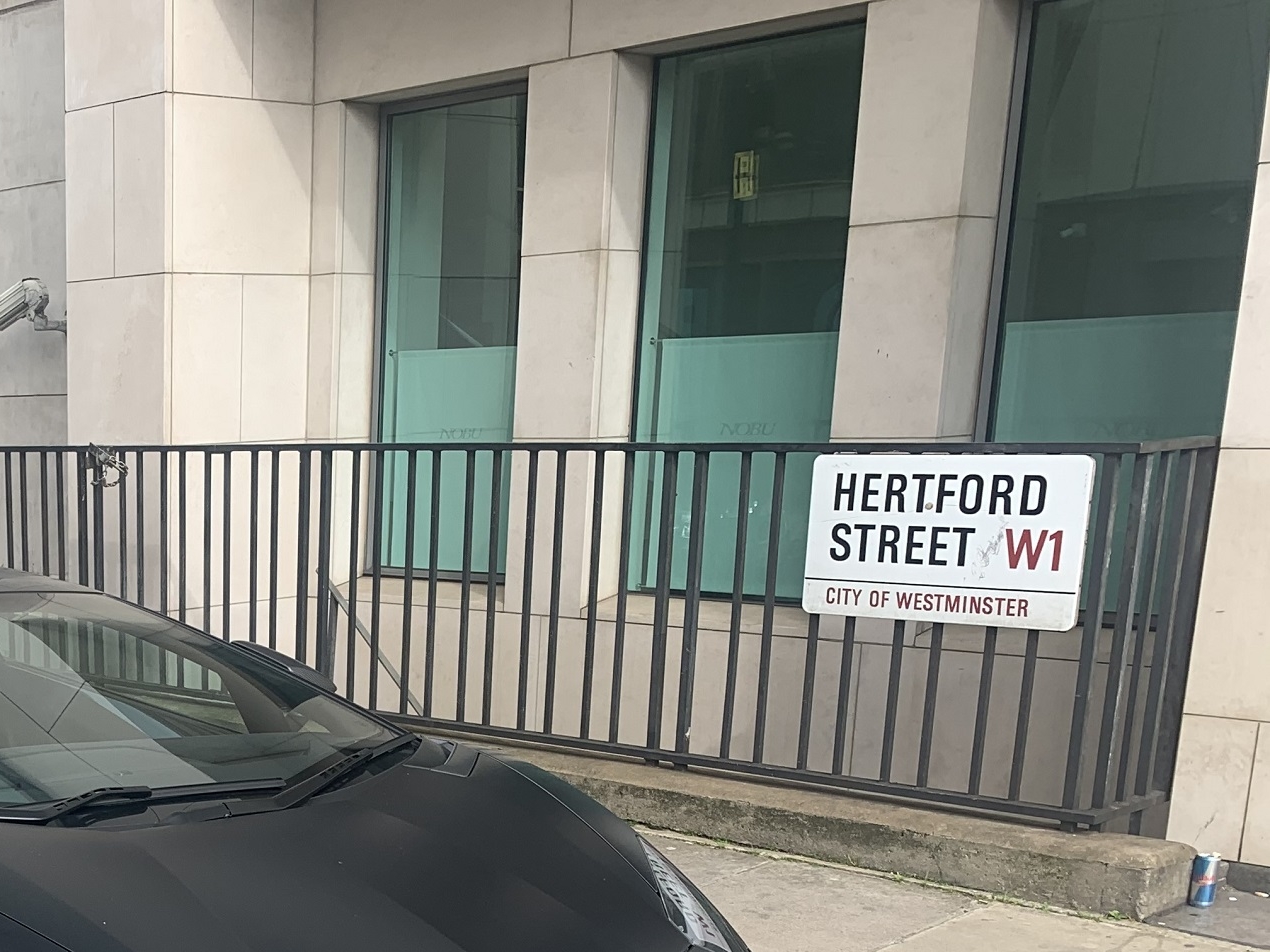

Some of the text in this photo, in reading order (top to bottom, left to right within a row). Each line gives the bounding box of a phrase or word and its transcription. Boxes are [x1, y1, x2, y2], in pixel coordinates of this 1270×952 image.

[439, 427, 482, 439] NOBU
[720, 422, 777, 436] NOBU
[833, 473, 1048, 516] HERTFORD
[830, 523, 1064, 572] STREET W1
[826, 587, 1029, 618] CITY OF WESTMINSTER
